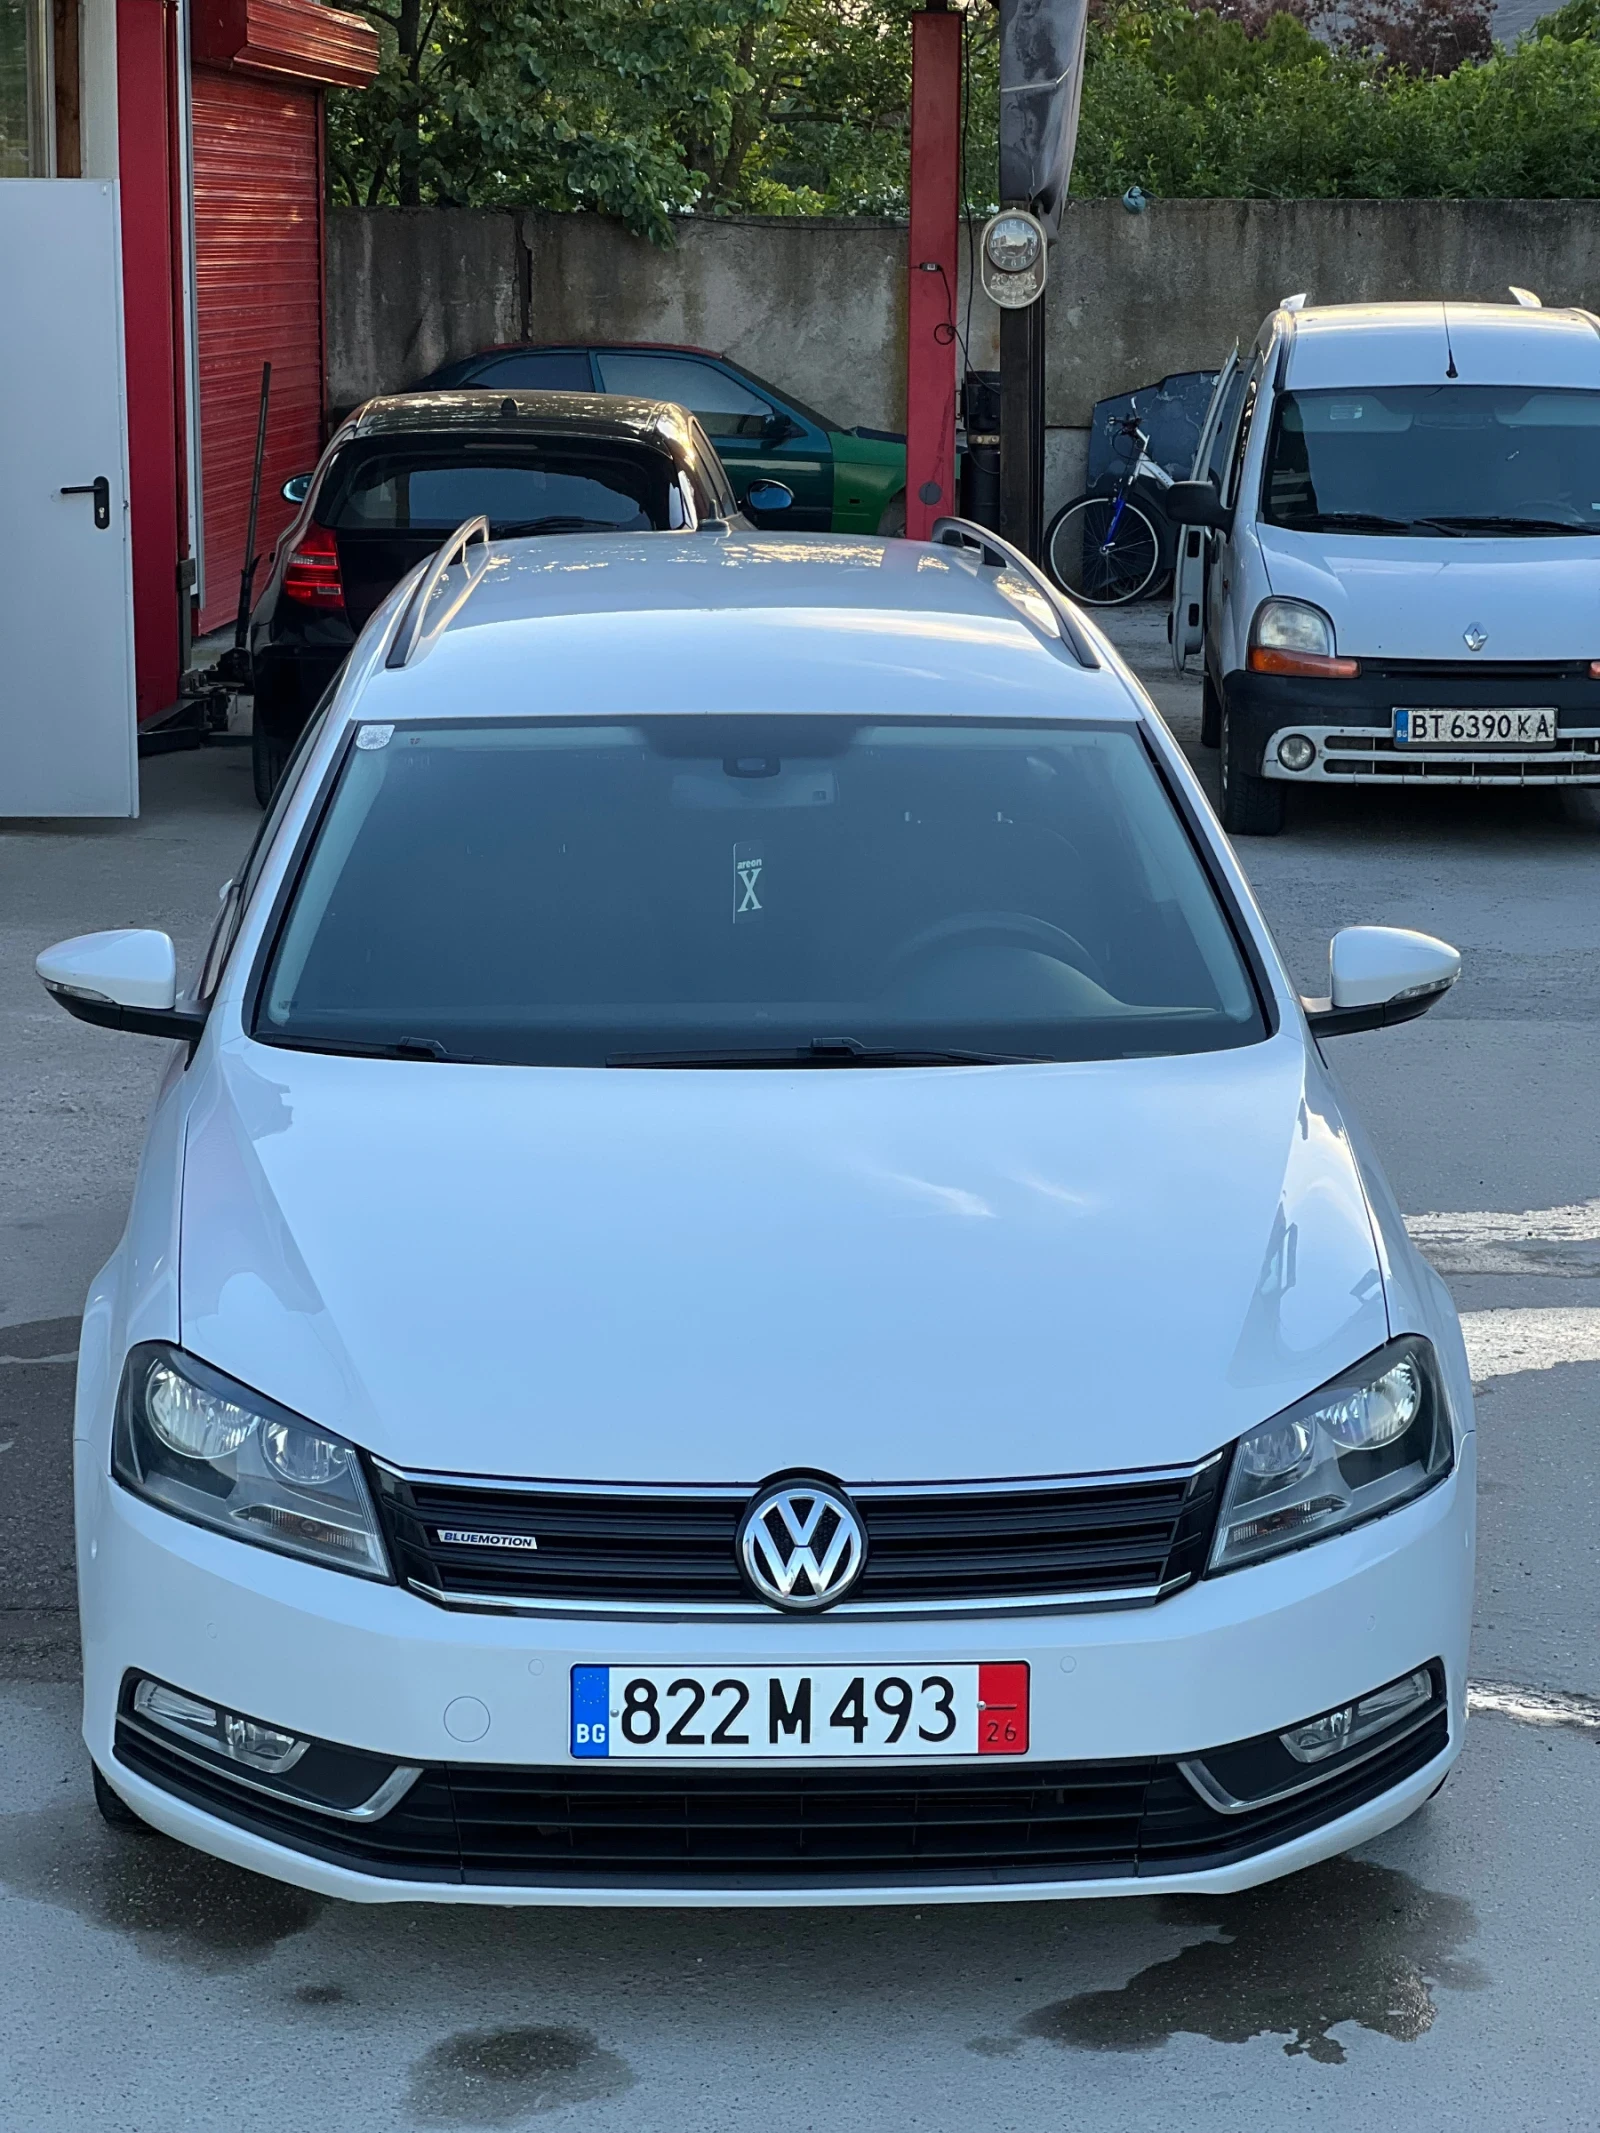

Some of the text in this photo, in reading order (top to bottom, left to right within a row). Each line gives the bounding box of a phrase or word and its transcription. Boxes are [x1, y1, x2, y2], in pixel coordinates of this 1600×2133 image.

[1412, 714, 1444, 738] BT
[1451, 714, 1511, 738] 6390
[737, 858, 763, 870] areon
[737, 868, 763, 912] X
[443, 1532, 532, 1547] BLUEMOTION
[621, 1676, 957, 1745] 822 M 493
[576, 1723, 606, 1744] BG
[986, 1720, 1017, 1743] 26
